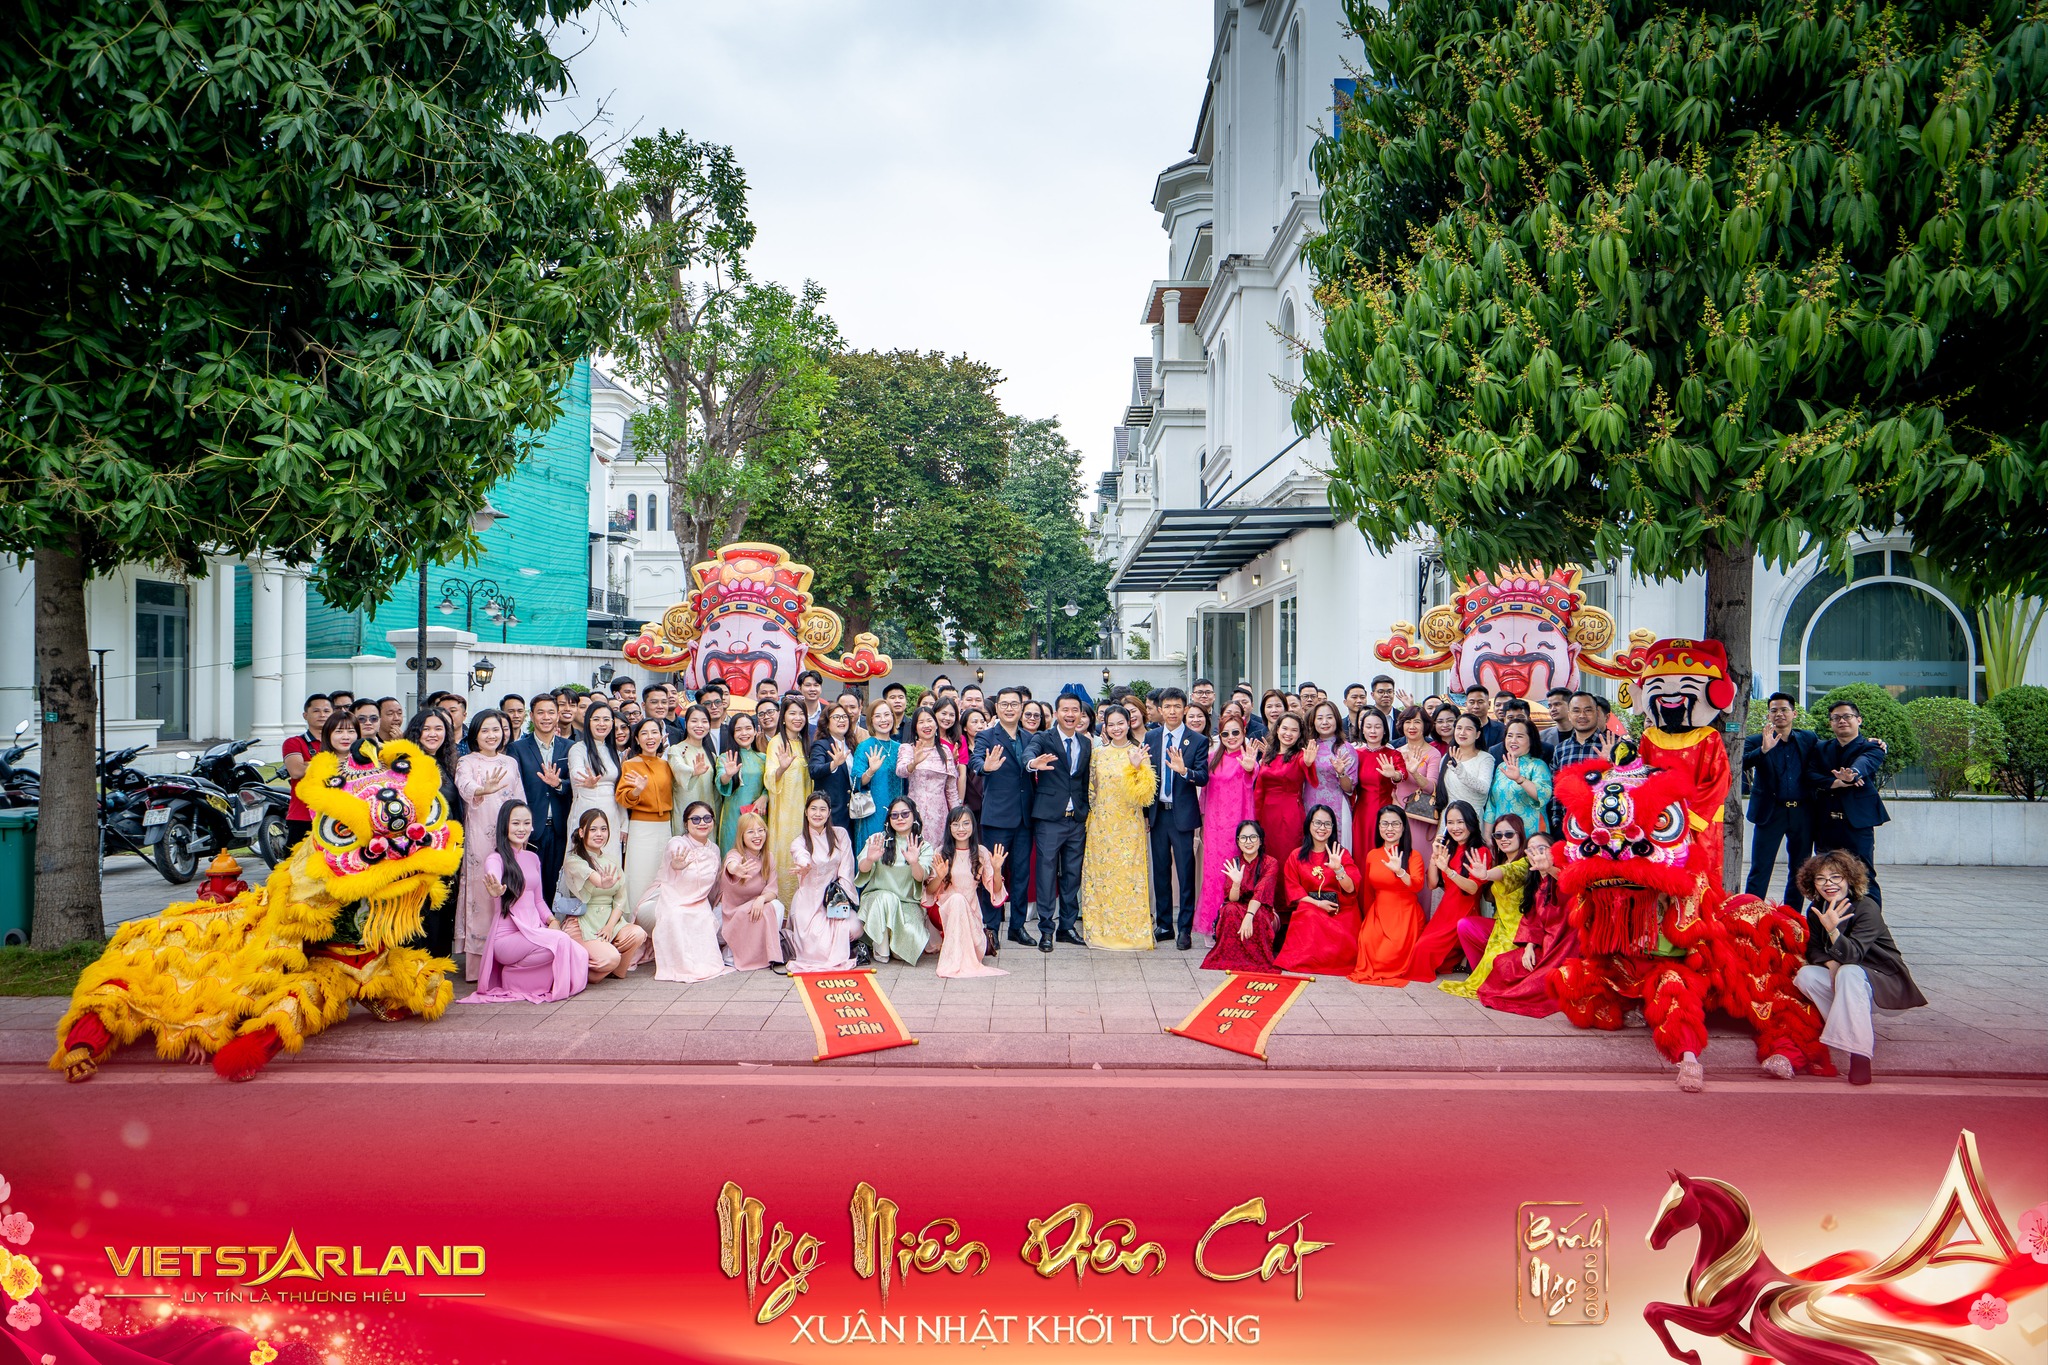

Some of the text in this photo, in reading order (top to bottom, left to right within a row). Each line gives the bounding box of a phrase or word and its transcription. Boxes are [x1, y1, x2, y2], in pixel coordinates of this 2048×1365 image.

[816, 979, 858, 988] CUNG
[1246, 981, 1279, 992] VẠN
[824, 990, 864, 1003] CHÚC
[835, 1005, 869, 1018] TÂN
[837, 1020, 885, 1036] XUÂN
[1218, 1021, 1233, 1034] Ý
